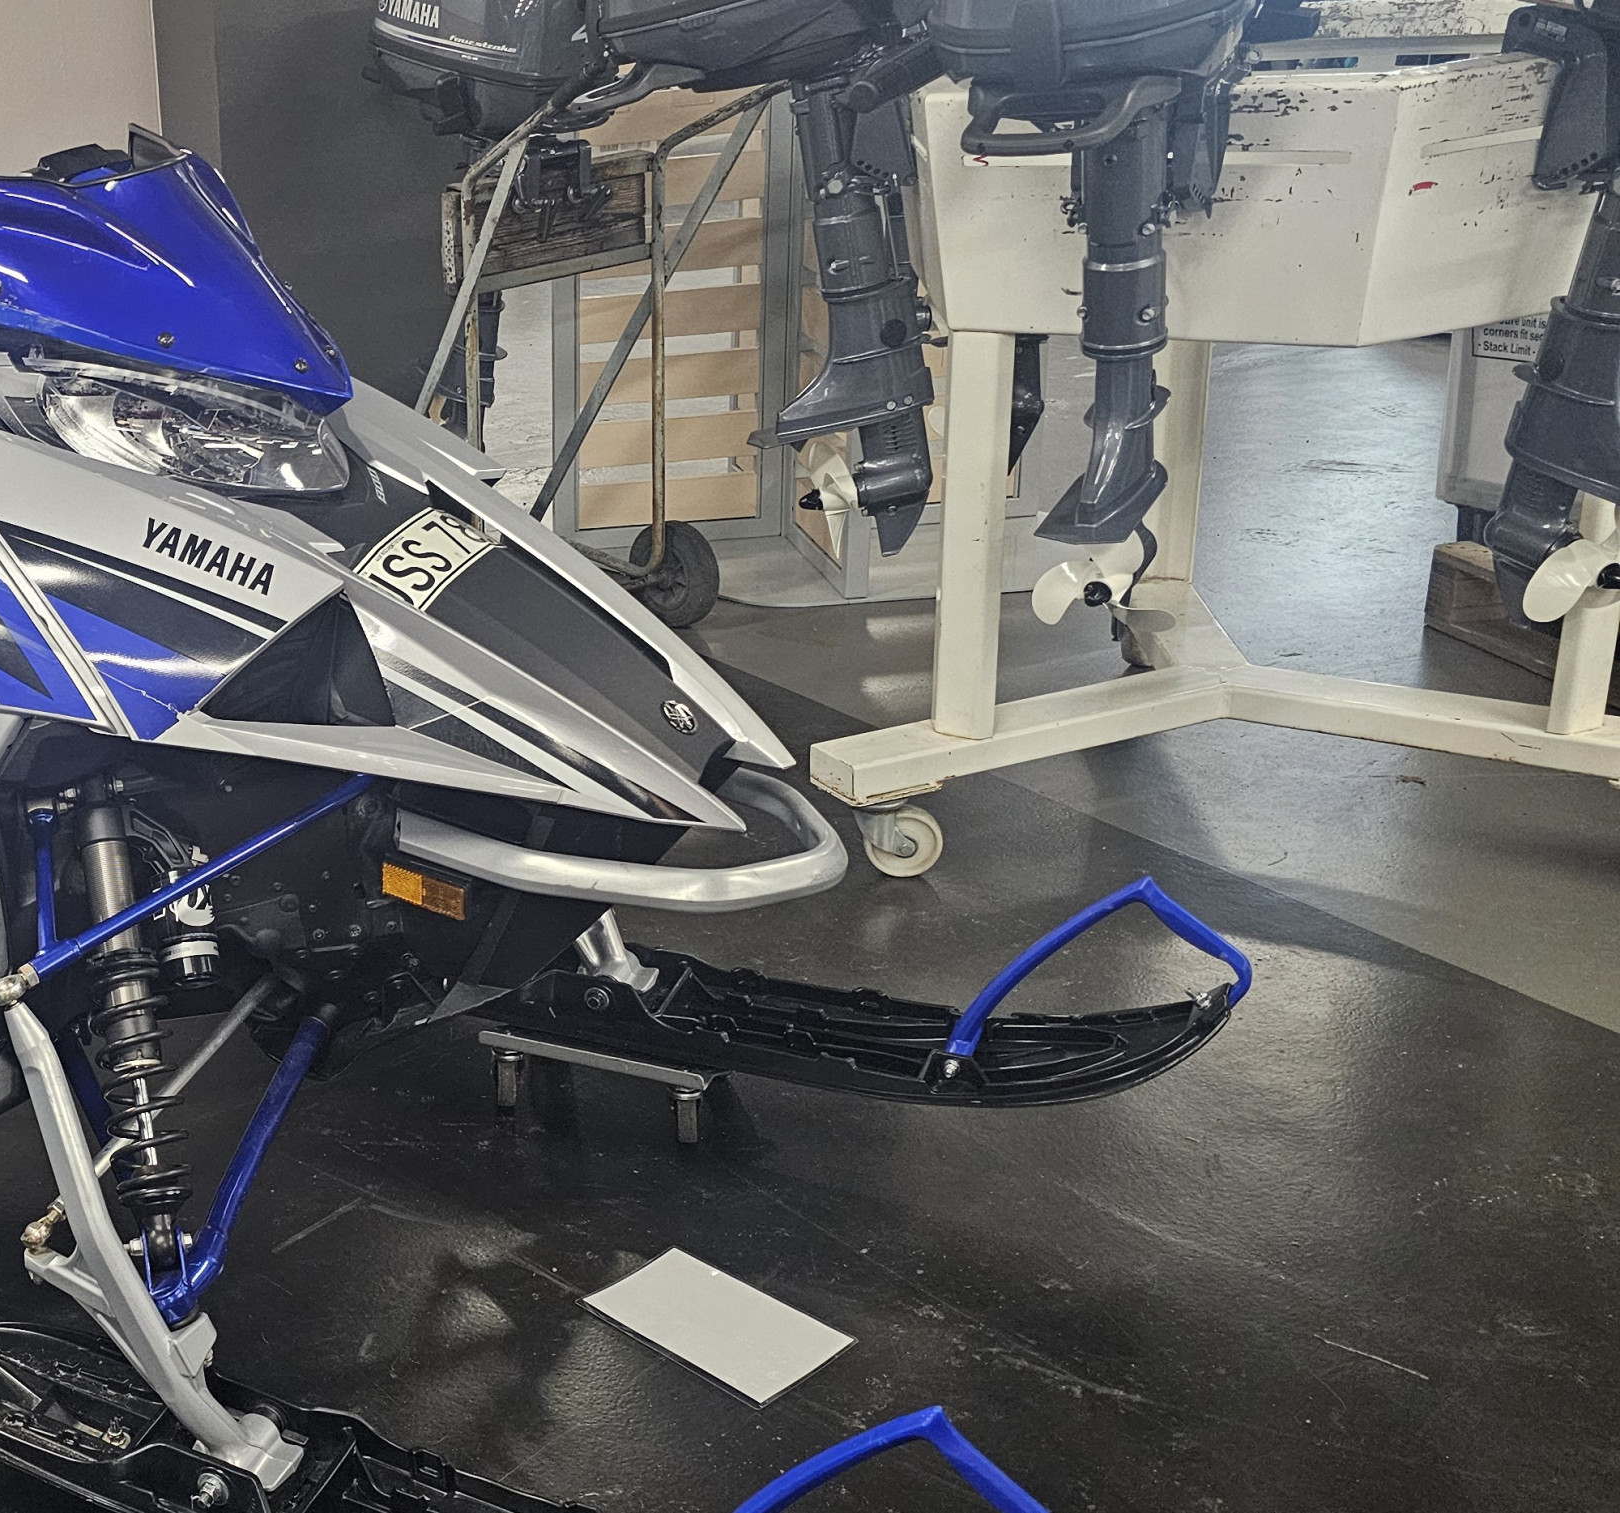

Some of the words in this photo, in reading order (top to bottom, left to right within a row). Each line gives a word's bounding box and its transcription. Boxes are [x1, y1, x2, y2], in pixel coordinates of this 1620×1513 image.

[387, 0, 439, 28] YAMAHA
[1483, 327, 1518, 339] corners
[1483, 340, 1508, 353] Stack
[1510, 343, 1531, 356] Limit
[142, 517, 275, 596] YAMAHA
